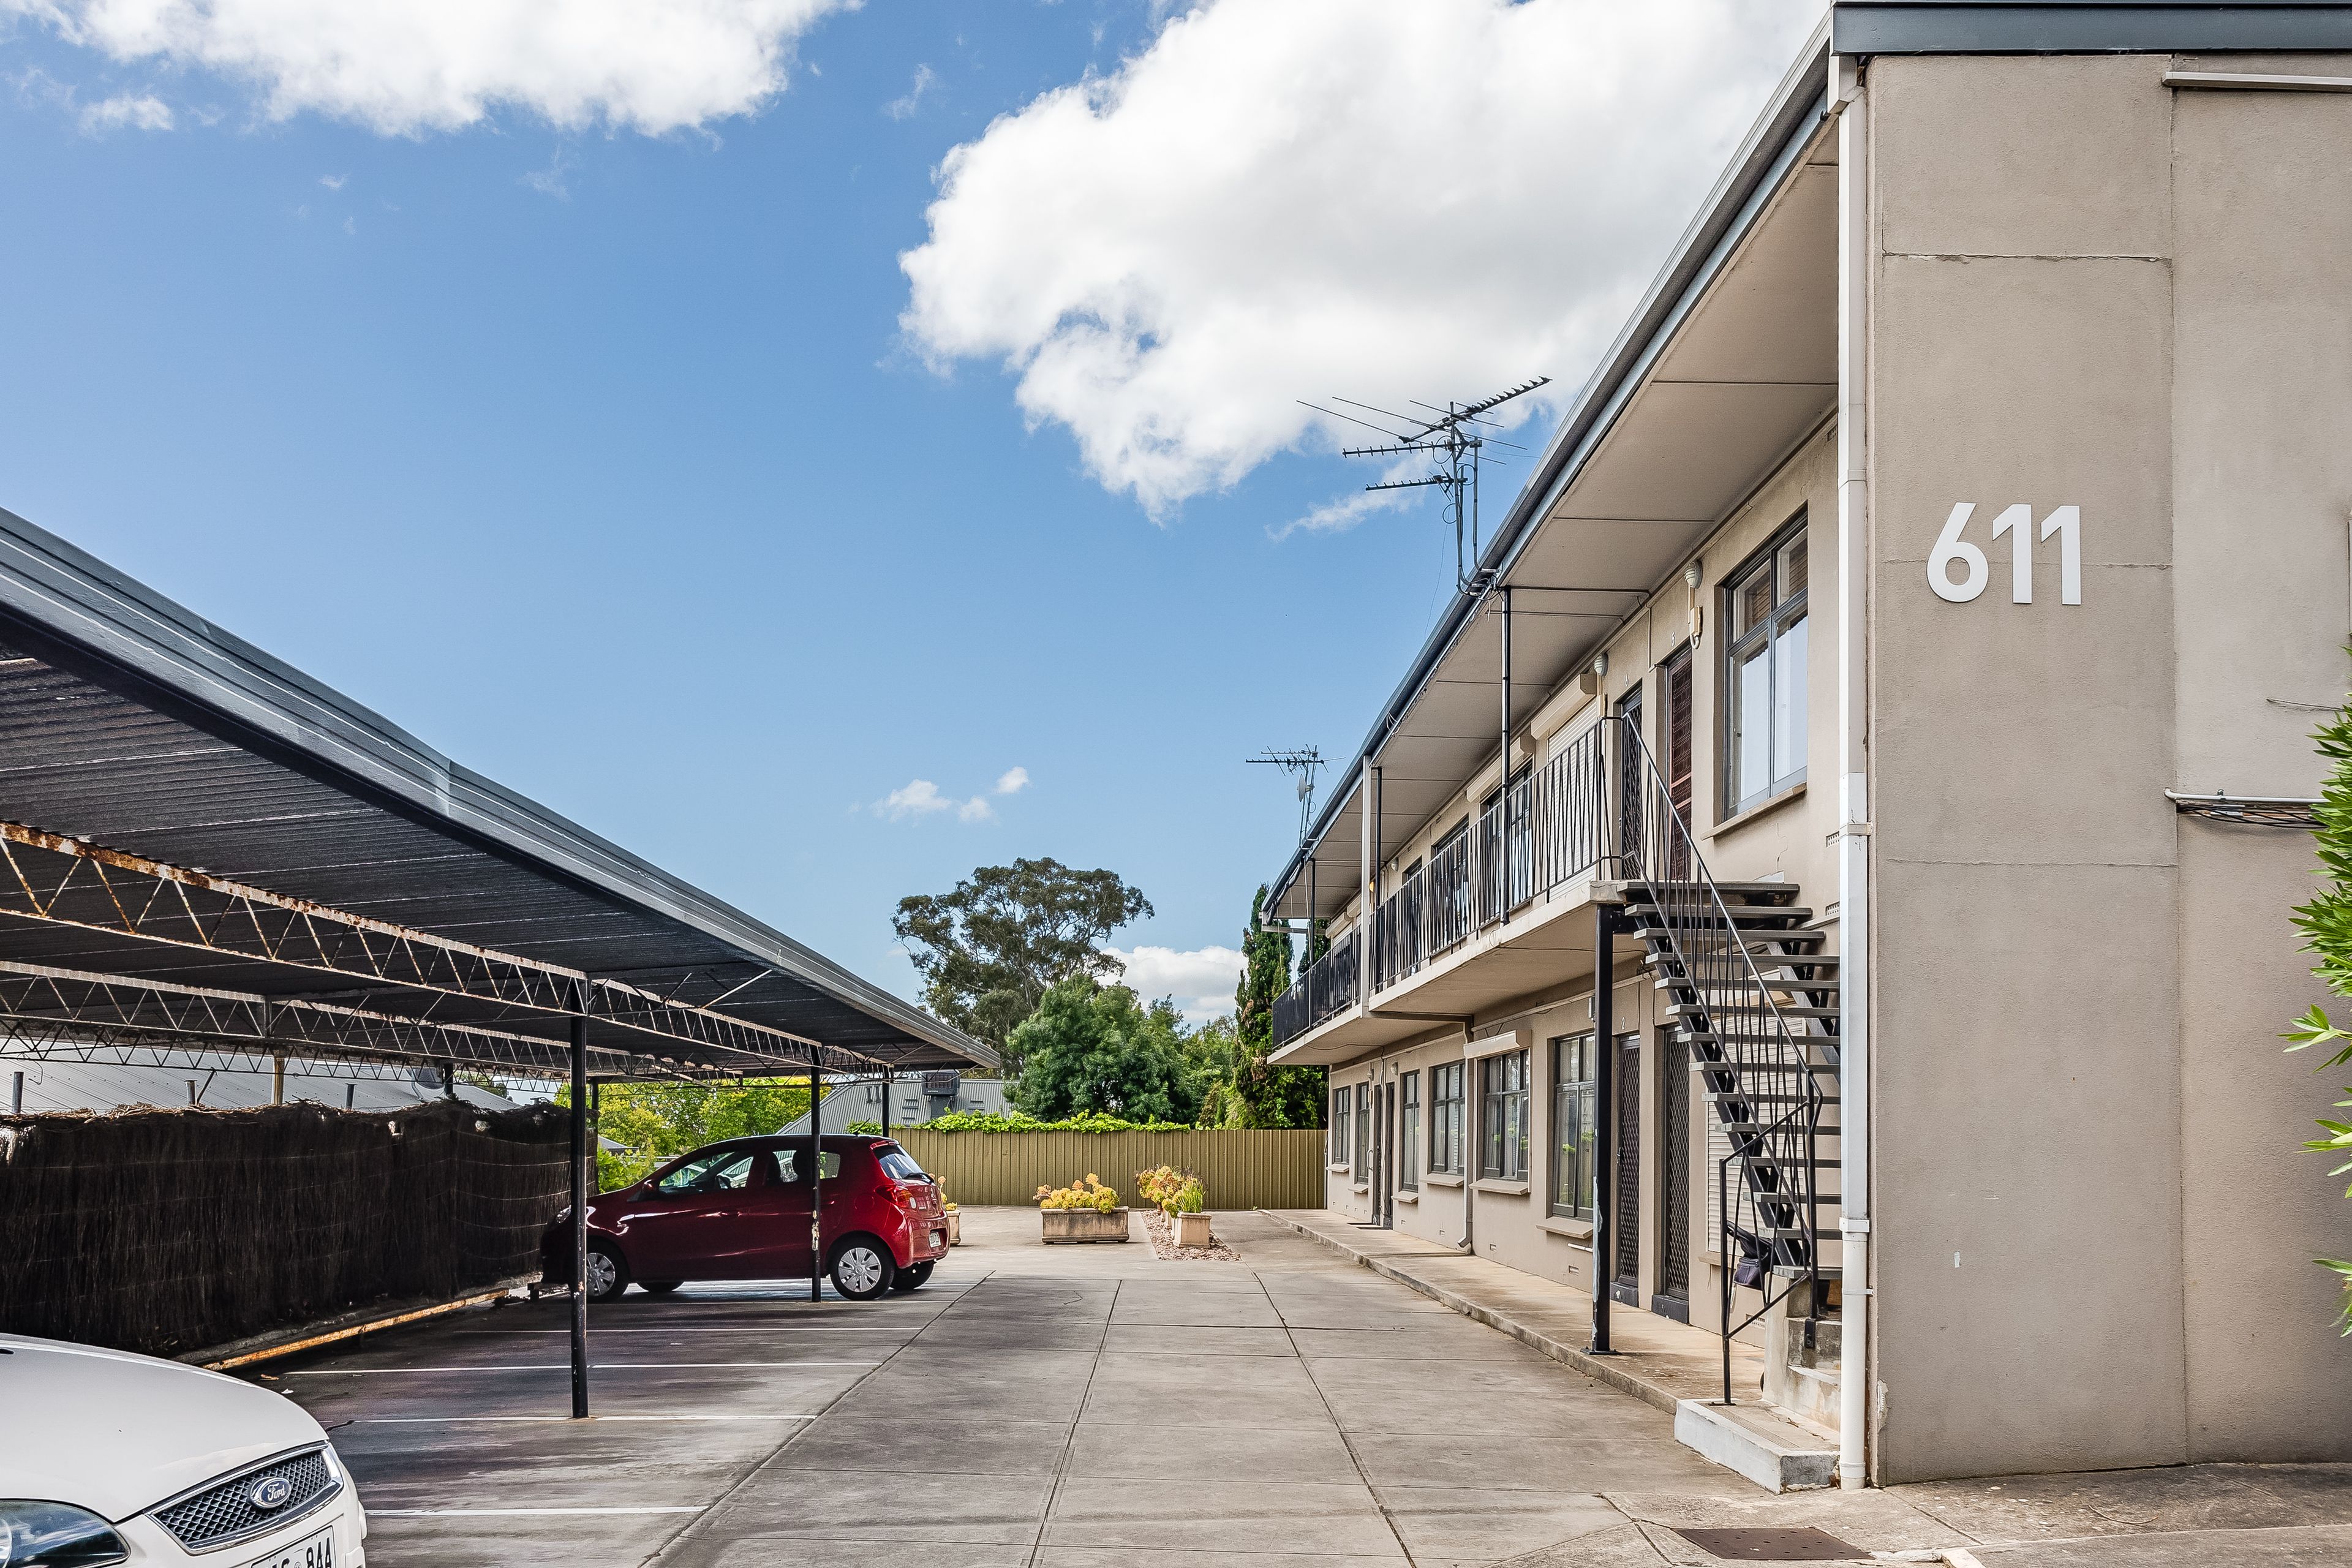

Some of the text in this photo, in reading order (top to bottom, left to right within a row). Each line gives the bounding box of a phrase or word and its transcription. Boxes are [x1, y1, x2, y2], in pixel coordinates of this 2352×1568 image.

[1926, 502, 2081, 605] 611
[1621, 1016, 1625, 1030] 2
[267, 1482, 285, 1501] Ford
